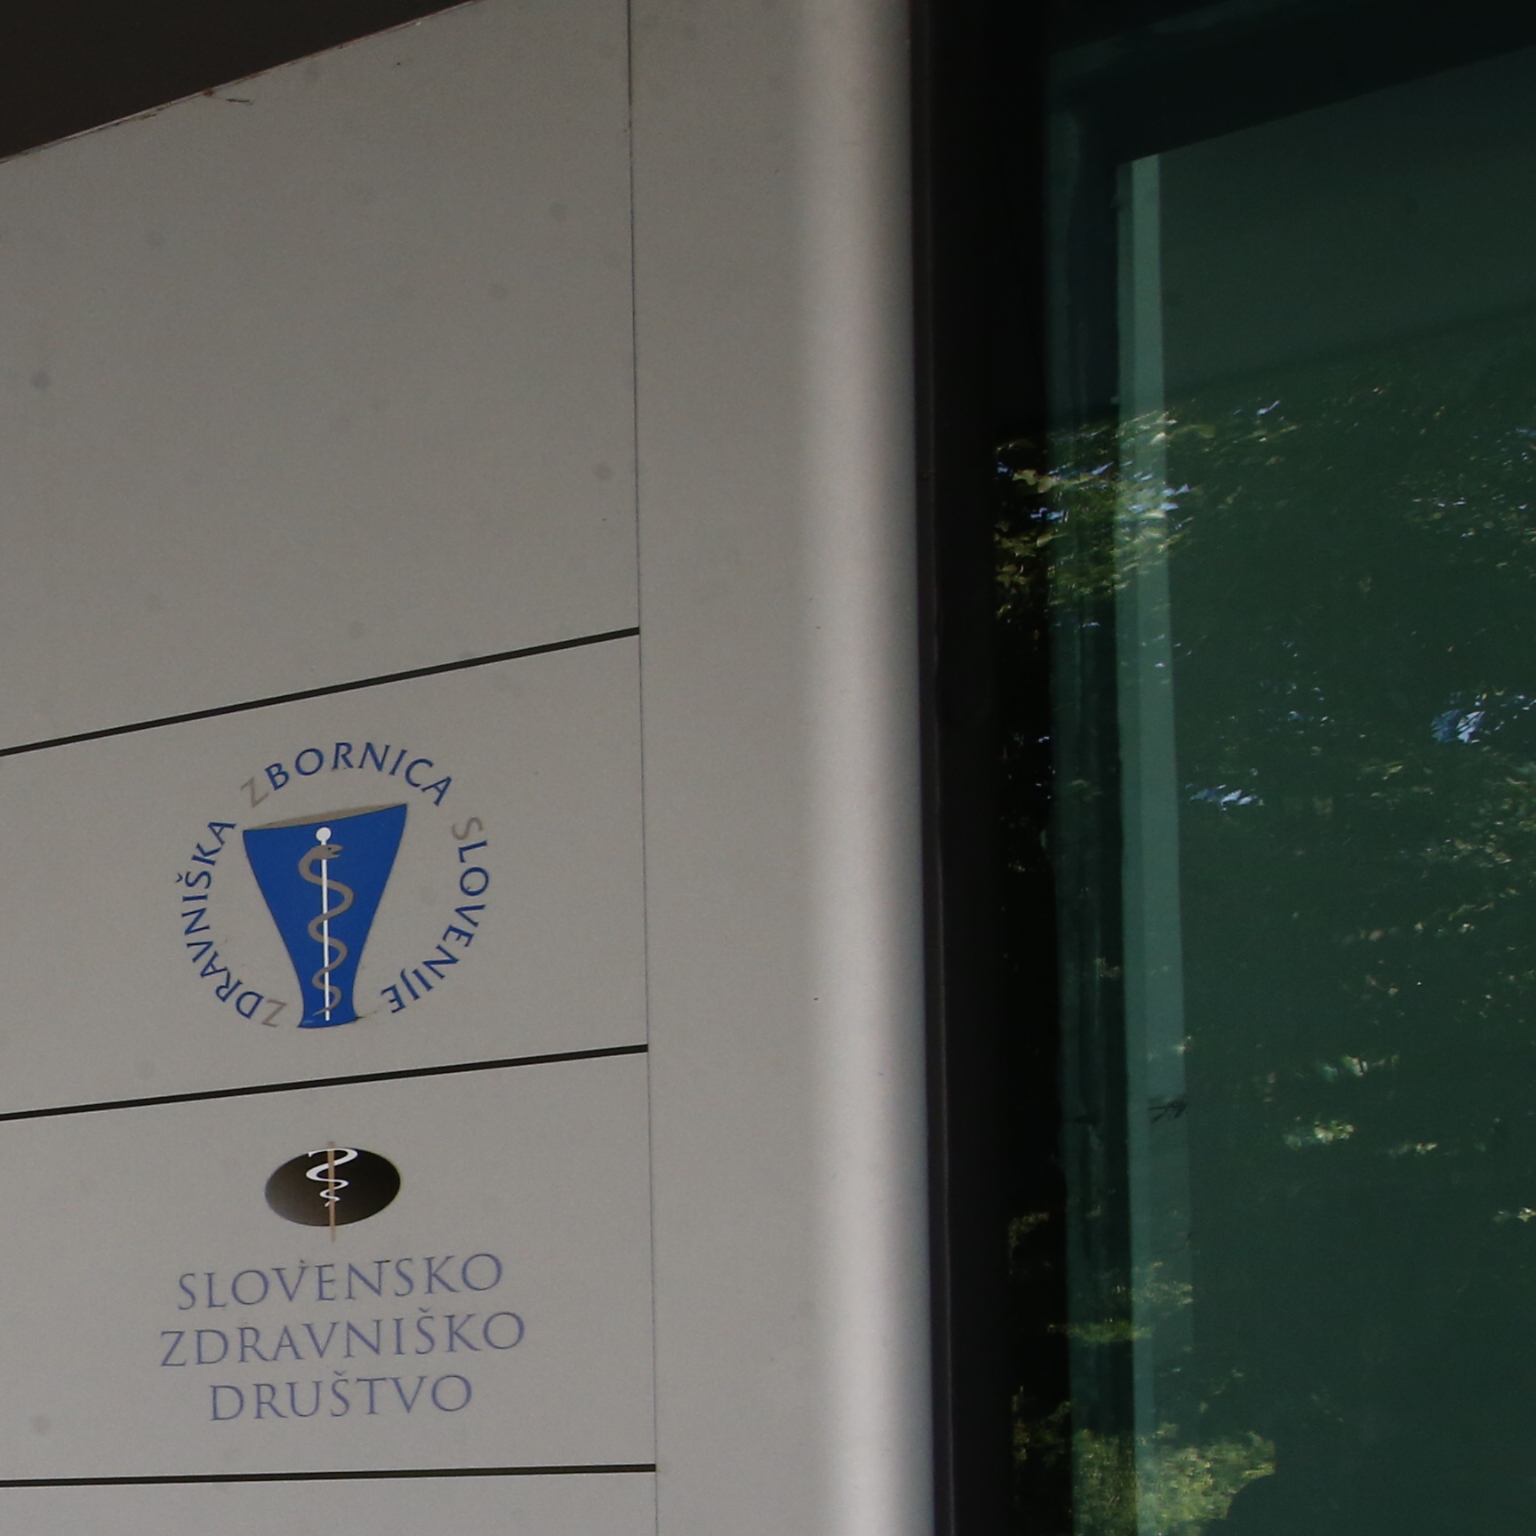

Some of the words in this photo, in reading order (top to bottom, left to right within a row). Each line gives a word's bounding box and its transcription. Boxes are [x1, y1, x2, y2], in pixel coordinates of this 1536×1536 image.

[240, 742, 453, 808] ZBORNICA
[175, 819, 288, 1029] ZDRAVNIŠKA
[380, 816, 490, 1015] SLOVENIJE
[178, 1252, 503, 1310] SLOVENSKO
[160, 1307, 525, 1367] ZDRAVNIŠKO
[210, 1371, 473, 1422] DRUŠTVO
